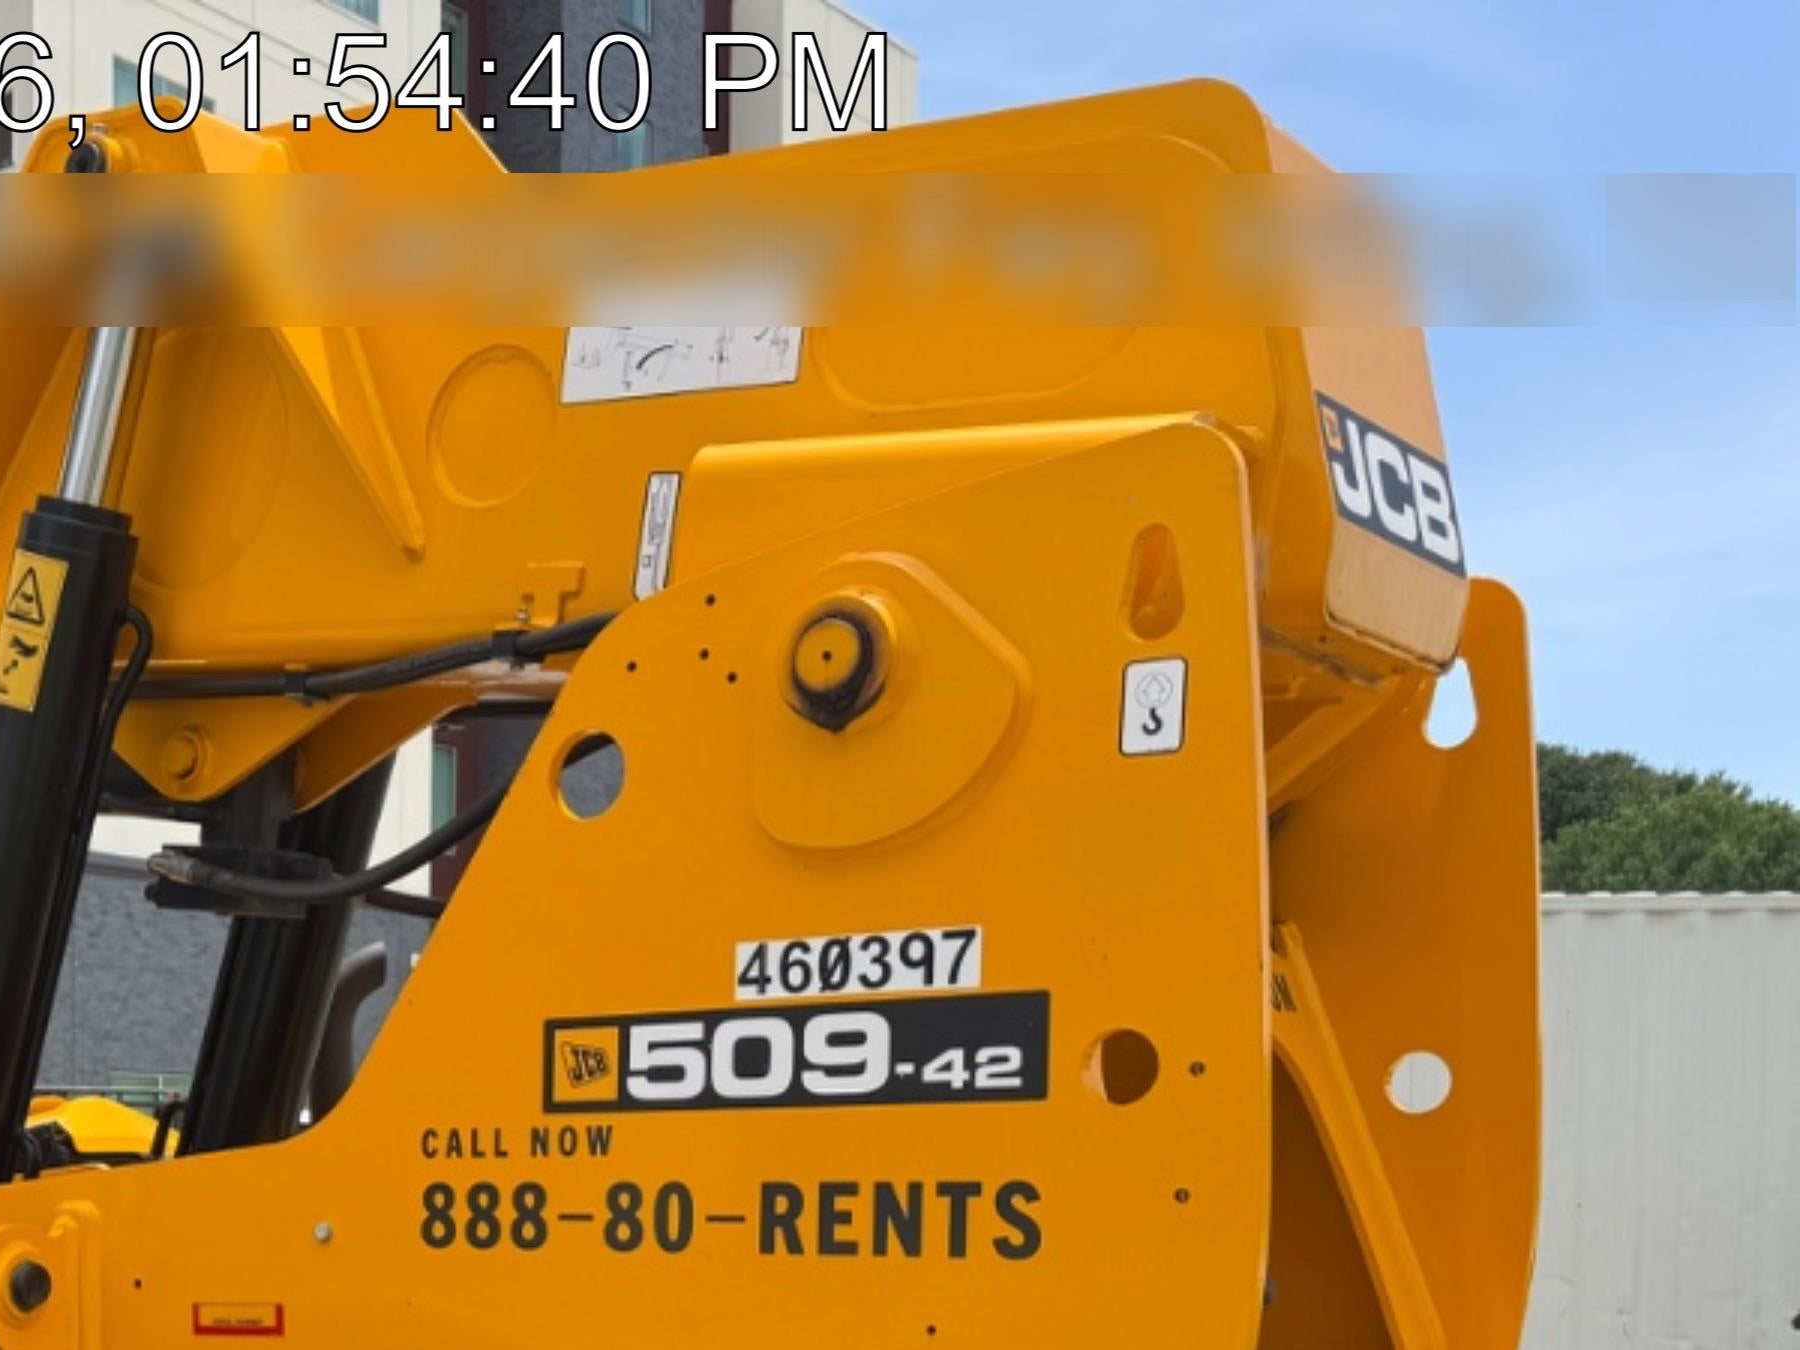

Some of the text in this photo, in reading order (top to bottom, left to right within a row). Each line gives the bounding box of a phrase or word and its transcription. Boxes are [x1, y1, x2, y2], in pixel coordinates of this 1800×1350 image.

[1332, 419, 1461, 565] JCB
[736, 927, 977, 995] 460397
[626, 1010, 1024, 1101] 509-42
[420, 1125, 614, 1159] CALL NOW
[420, 1180, 1043, 1260] 888-80-RENTS
